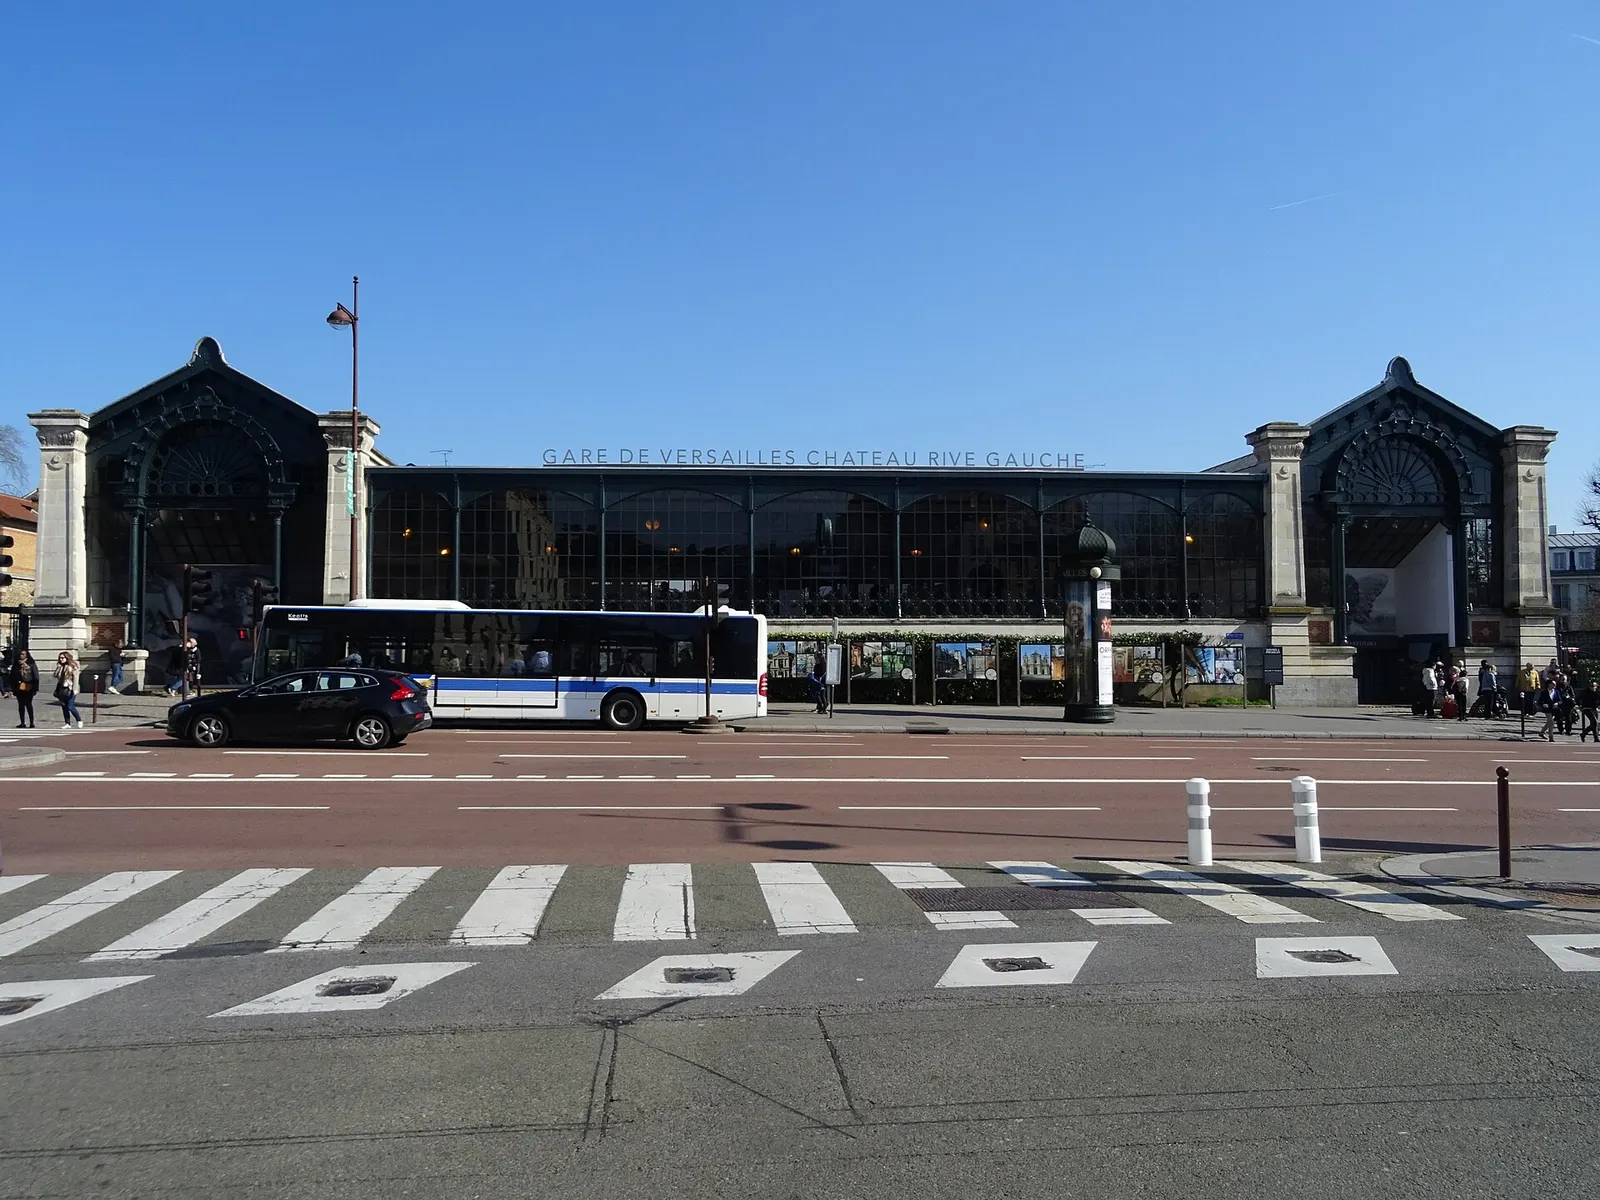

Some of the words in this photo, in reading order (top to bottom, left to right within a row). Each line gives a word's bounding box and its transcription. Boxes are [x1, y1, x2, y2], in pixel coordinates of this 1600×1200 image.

[542, 448, 608, 465] GARE
[620, 448, 650, 465] DE
[659, 448, 796, 466] VERSAILLES
[806, 450, 917, 467] CHATEAU
[929, 451, 976, 467] RIVE
[986, 452, 1085, 468] GAUCHE
